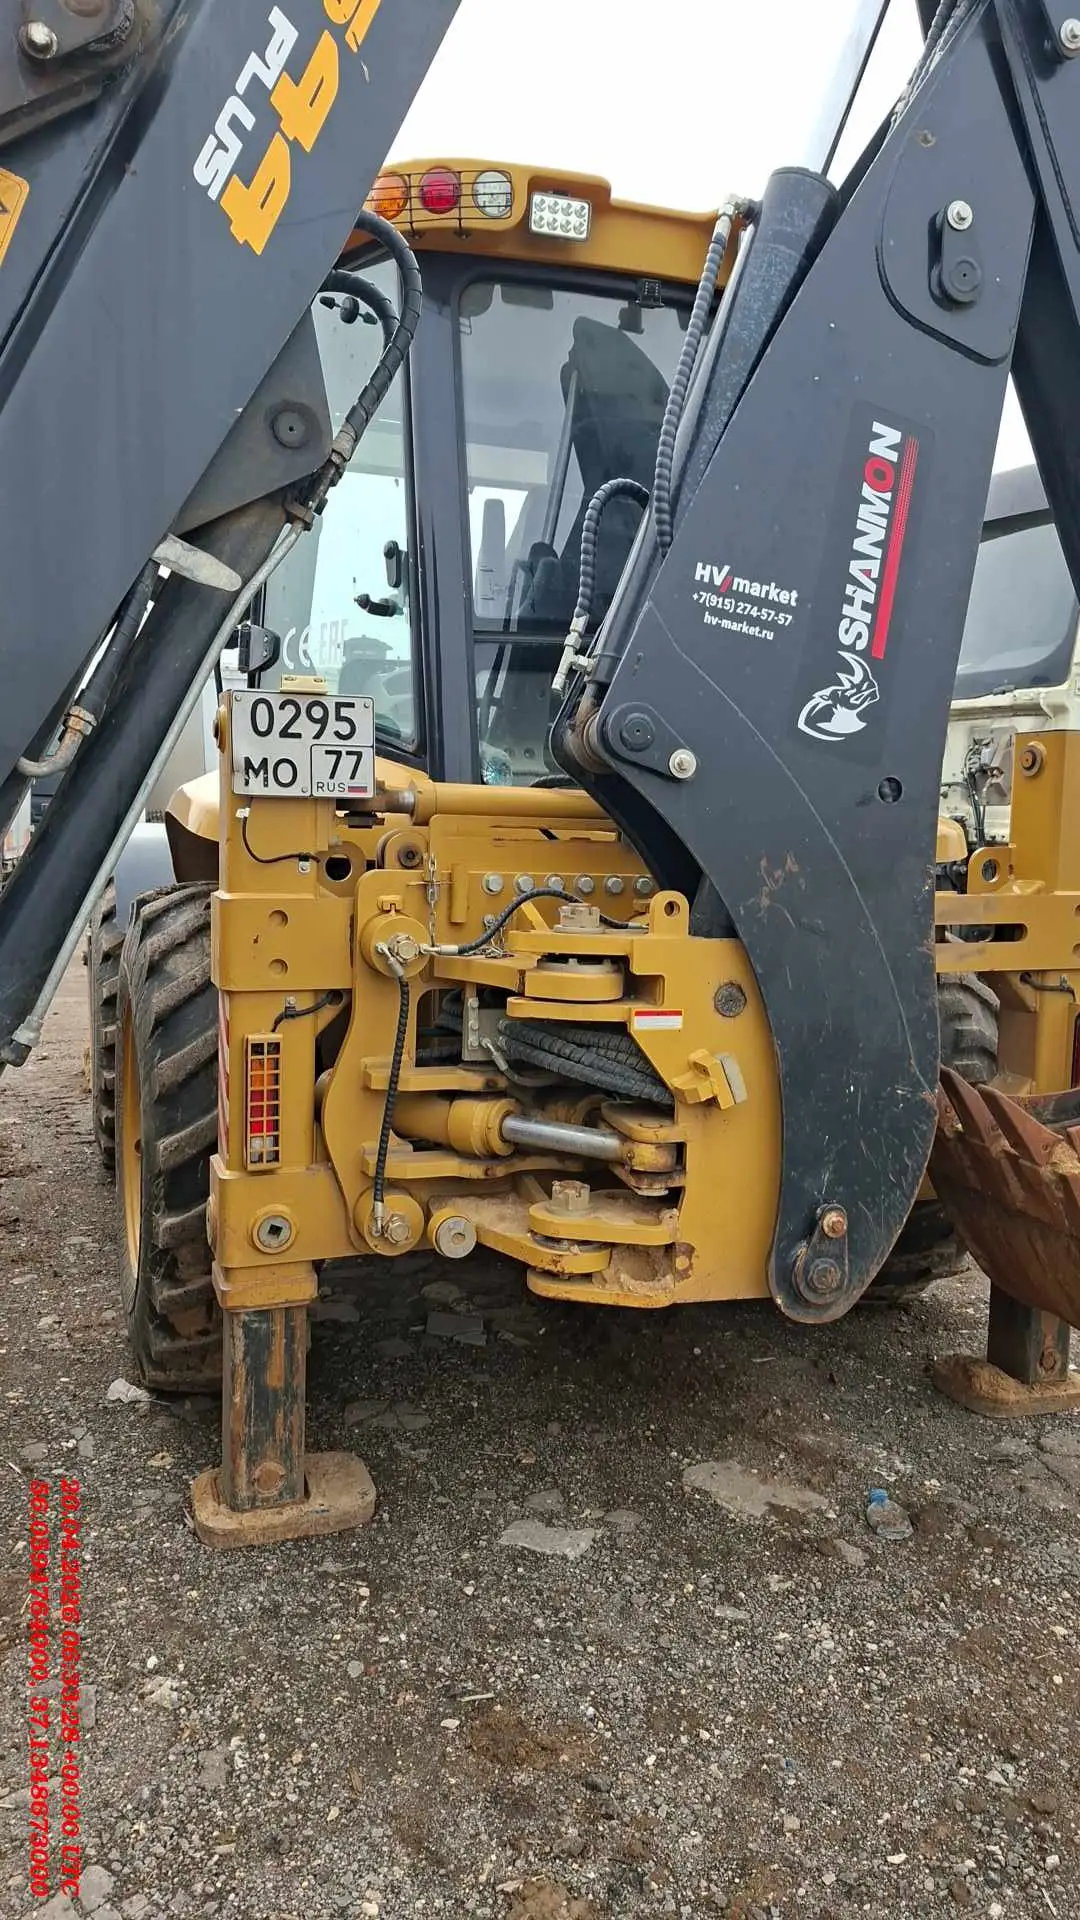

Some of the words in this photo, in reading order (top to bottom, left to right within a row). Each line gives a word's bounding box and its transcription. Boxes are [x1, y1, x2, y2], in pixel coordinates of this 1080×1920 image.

[193, 5, 299, 201] PLUS
[838, 421, 902, 651] SHANMON
[692, 591, 736, 613] +7(915)
[736, 601, 793, 627] 274-57-57
[703, 611, 774, 641] hv-market.ru
[250, 697, 357, 741] 0295
[243, 756, 298, 788] MO
[324, 749, 363, 780] 77
[316, 781, 346, 793] RUS
